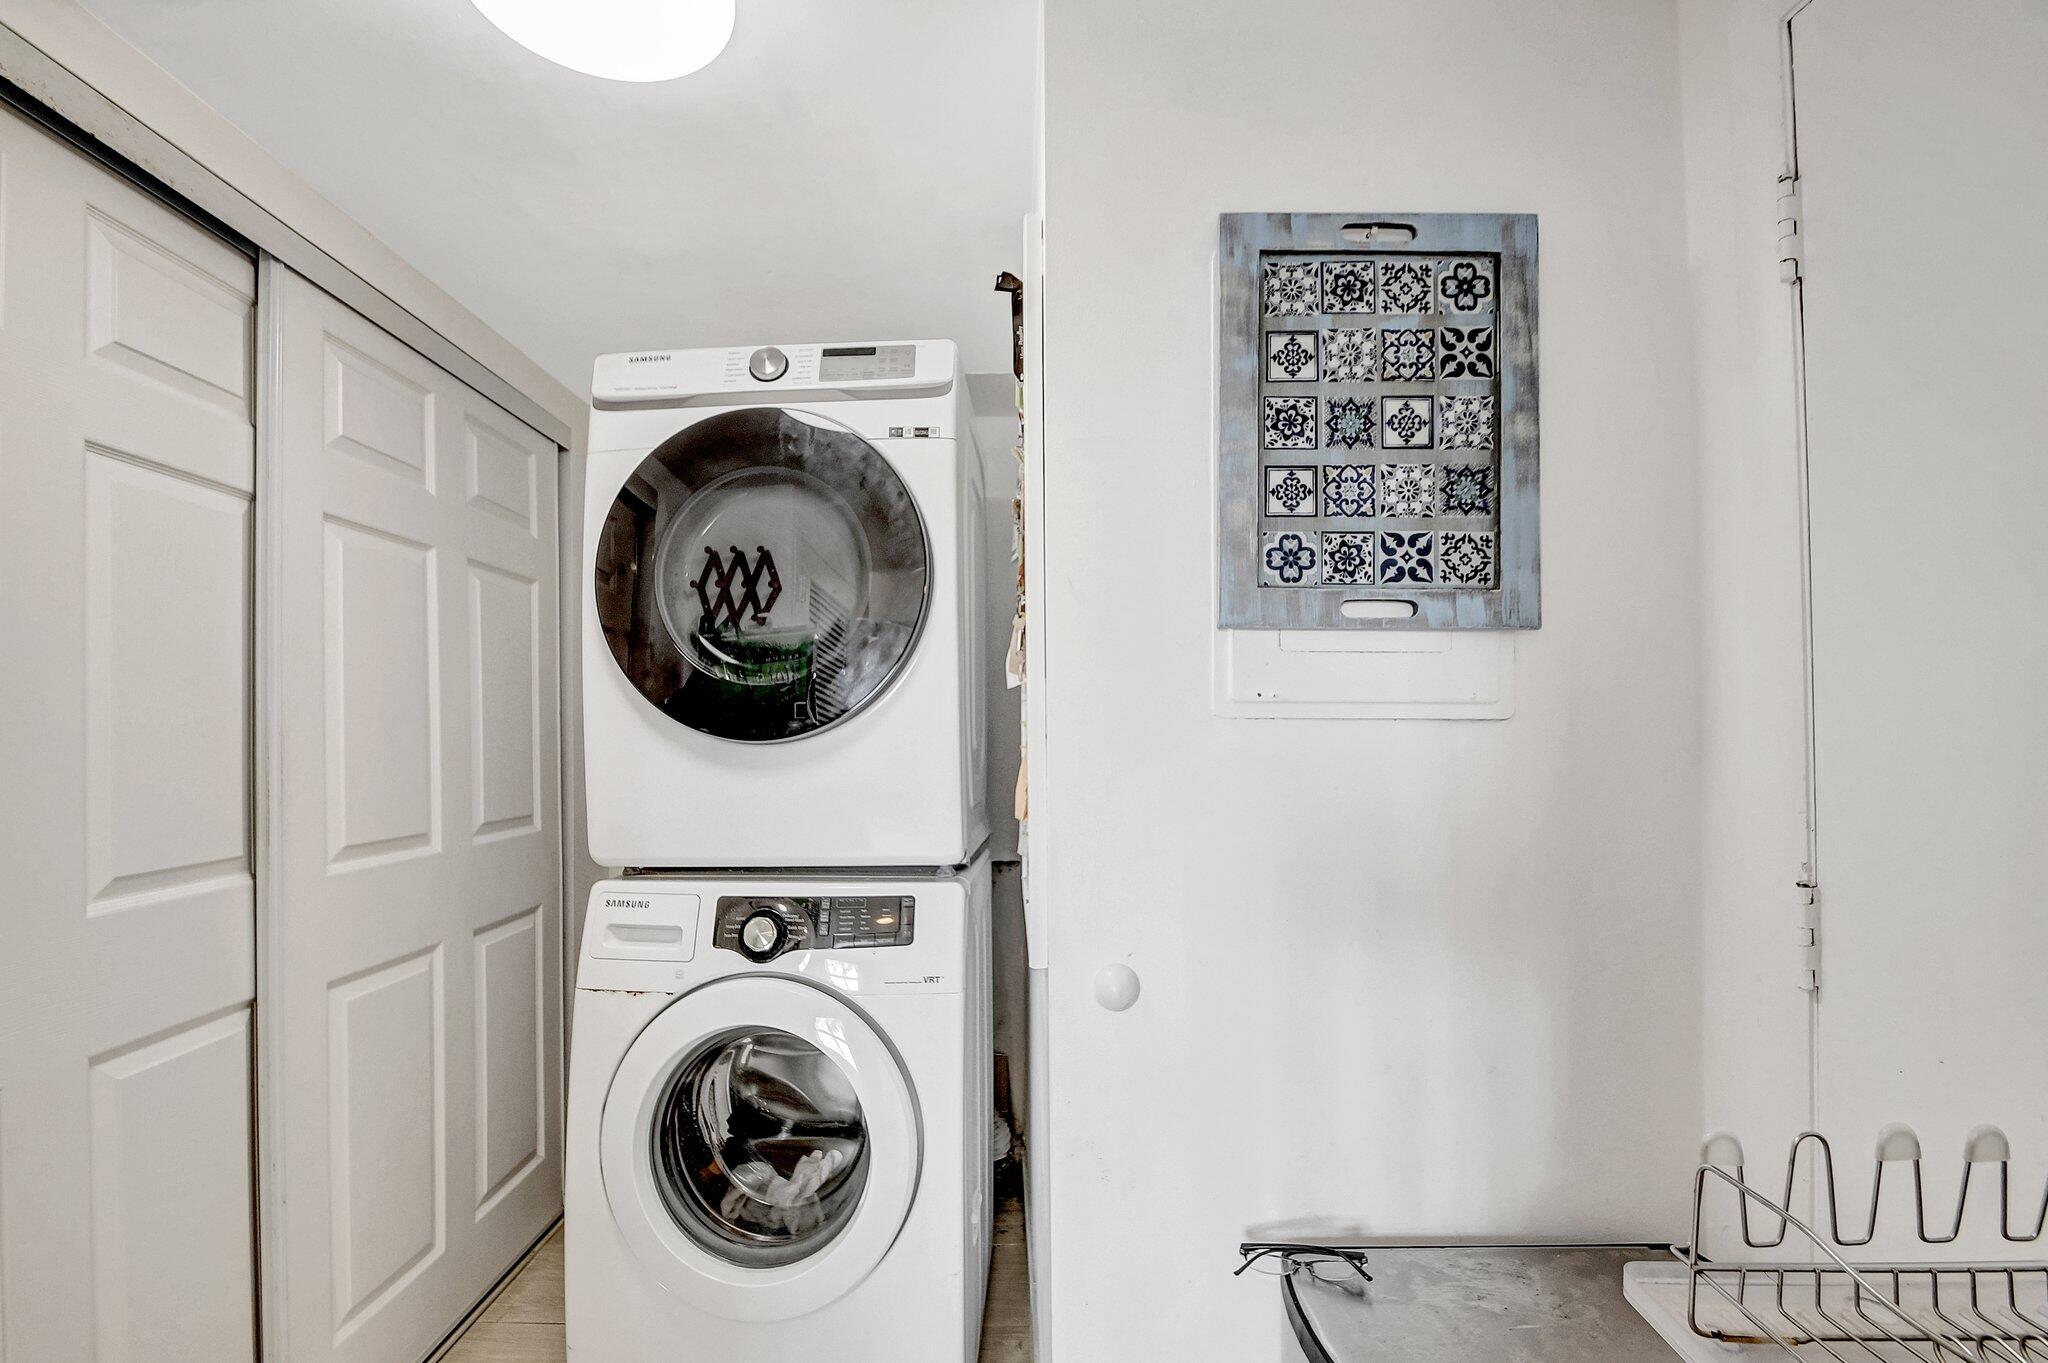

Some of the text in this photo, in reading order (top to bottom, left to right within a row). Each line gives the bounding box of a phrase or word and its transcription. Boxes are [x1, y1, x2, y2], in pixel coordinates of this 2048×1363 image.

[629, 354, 672, 363] SAMSUNG
[605, 899, 651, 909] SAMSUNG
[923, 976, 941, 984] VRT
